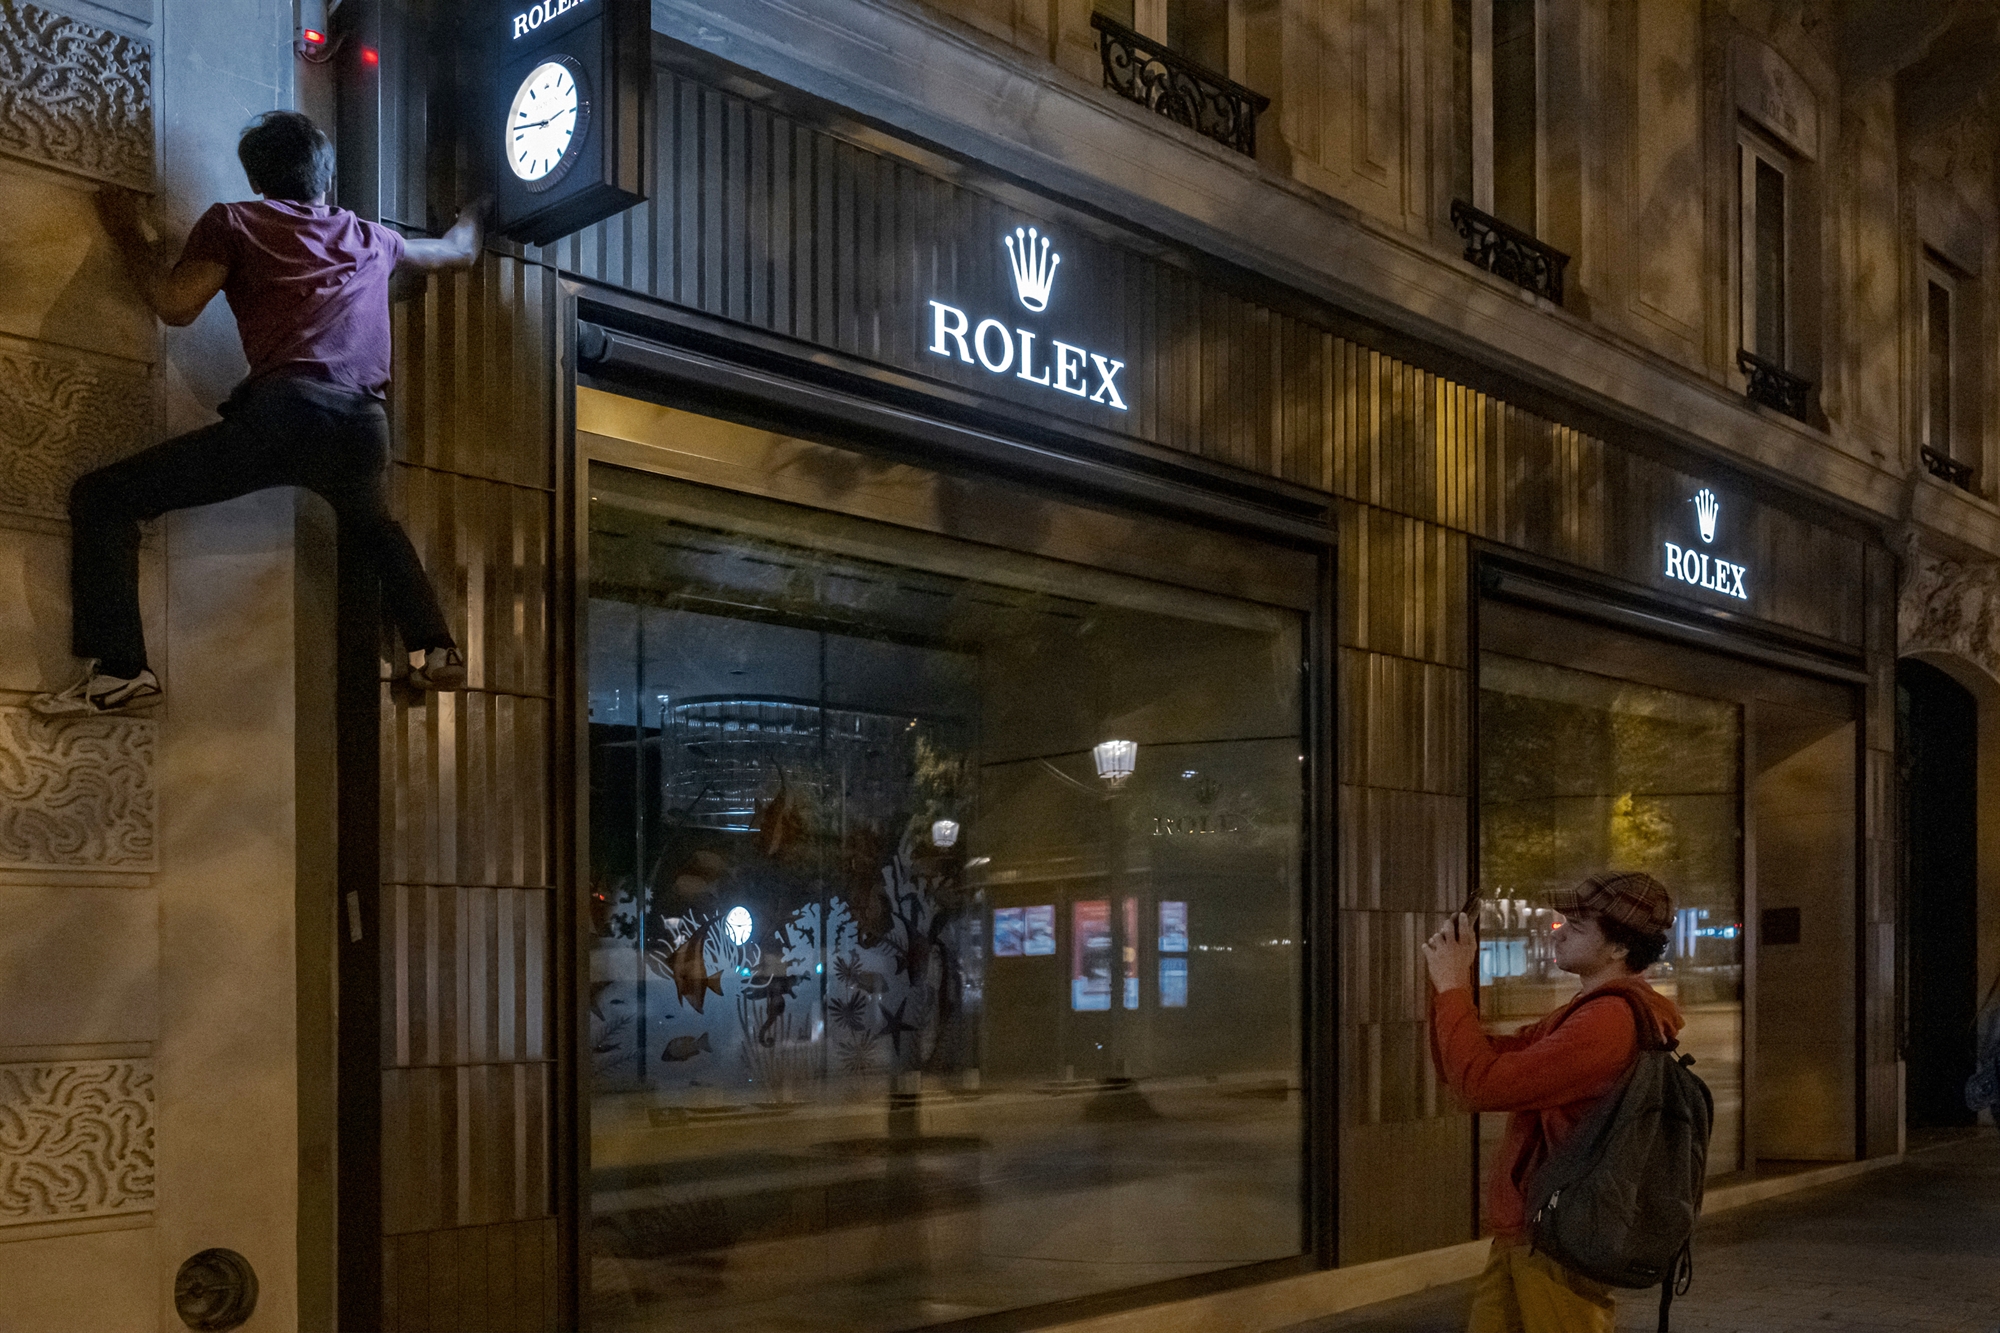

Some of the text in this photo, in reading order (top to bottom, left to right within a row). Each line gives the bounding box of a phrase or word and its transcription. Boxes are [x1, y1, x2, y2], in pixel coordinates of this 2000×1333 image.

[513, 0, 584, 39] ROLE
[929, 300, 1127, 410] ROLEX
[1665, 542, 1747, 599] ROLEX
